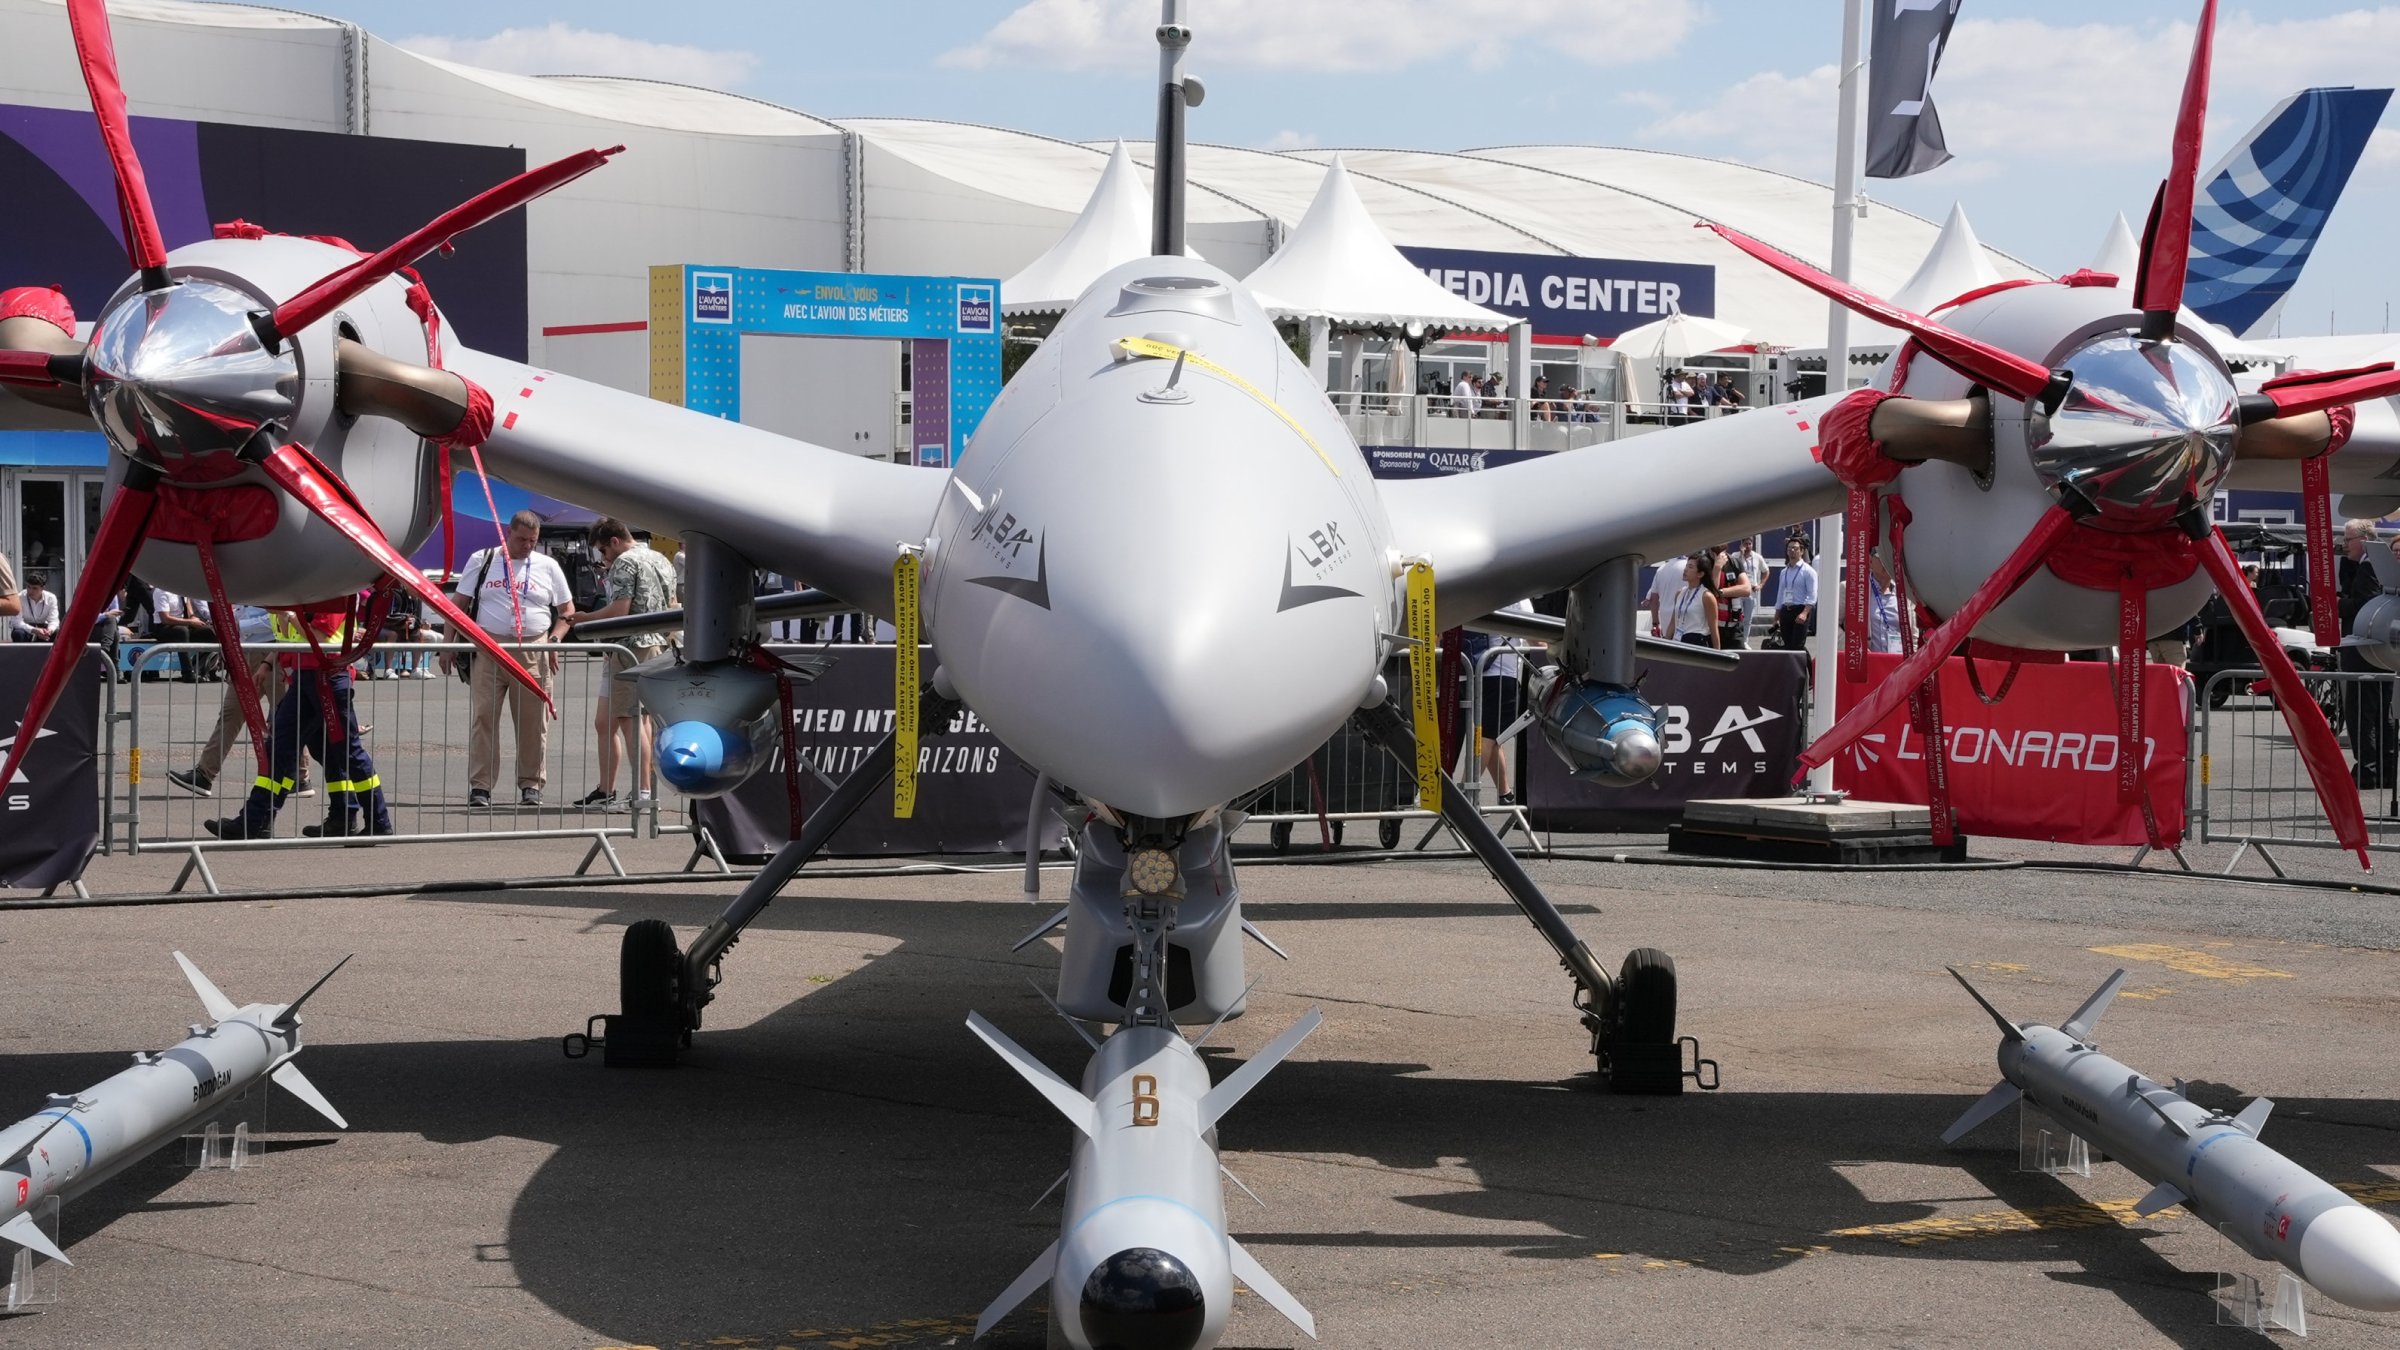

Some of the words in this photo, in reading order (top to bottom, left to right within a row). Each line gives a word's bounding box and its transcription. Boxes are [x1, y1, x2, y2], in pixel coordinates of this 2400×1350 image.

[1541, 275, 1681, 314] CENTER
[783, 304, 808, 319] AVEC
[810, 305, 846, 321] L'AVION
[849, 307, 867, 321] DES
[869, 304, 909, 323] MÉTIERS
[1372, 450, 1413, 459] SPONSORISÉ
[1429, 452, 1470, 468] QATAR
[1379, 459, 1412, 469] Sponsored
[1412, 460, 1421, 470] by
[1423, 588, 1431, 605] GÜÇ
[908, 659, 916, 682] ÖNCE
[1416, 699, 1422, 710] UP
[793, 708, 846, 733] FIED
[1652, 705, 1784, 753] BA
[769, 747, 876, 773] IFINIT
[917, 747, 1000, 773] RIZONS
[1664, 762, 1767, 774] TEMS
